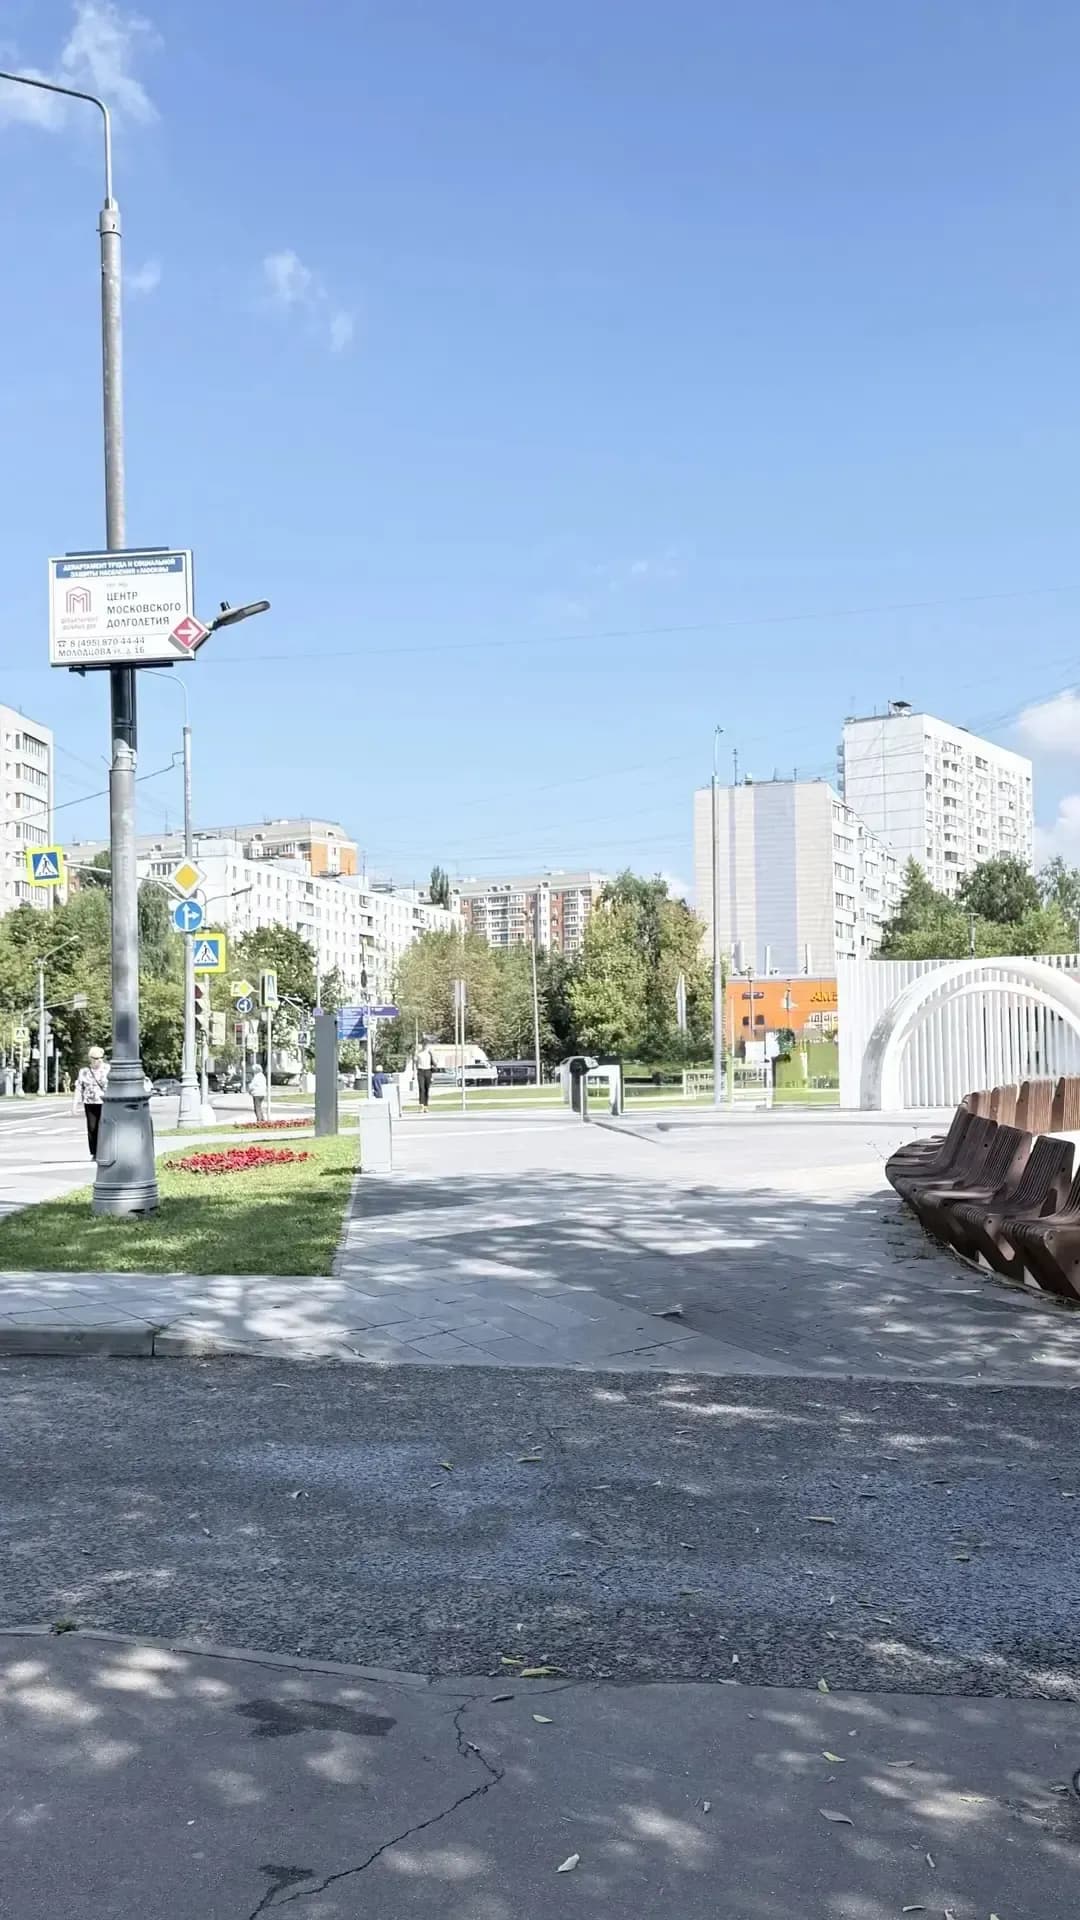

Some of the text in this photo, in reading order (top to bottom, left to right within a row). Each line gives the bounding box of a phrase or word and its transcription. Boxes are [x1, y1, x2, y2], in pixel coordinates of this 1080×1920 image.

[106, 592, 138, 601] ЦЕНТР
[107, 603, 181, 614] МОСКОВСКОГО
[106, 617, 170, 628] ДОЛГОЛЕТИЯ
[70, 640, 76, 648] 8
[58, 648, 112, 657] МОЛОДЦОВА
